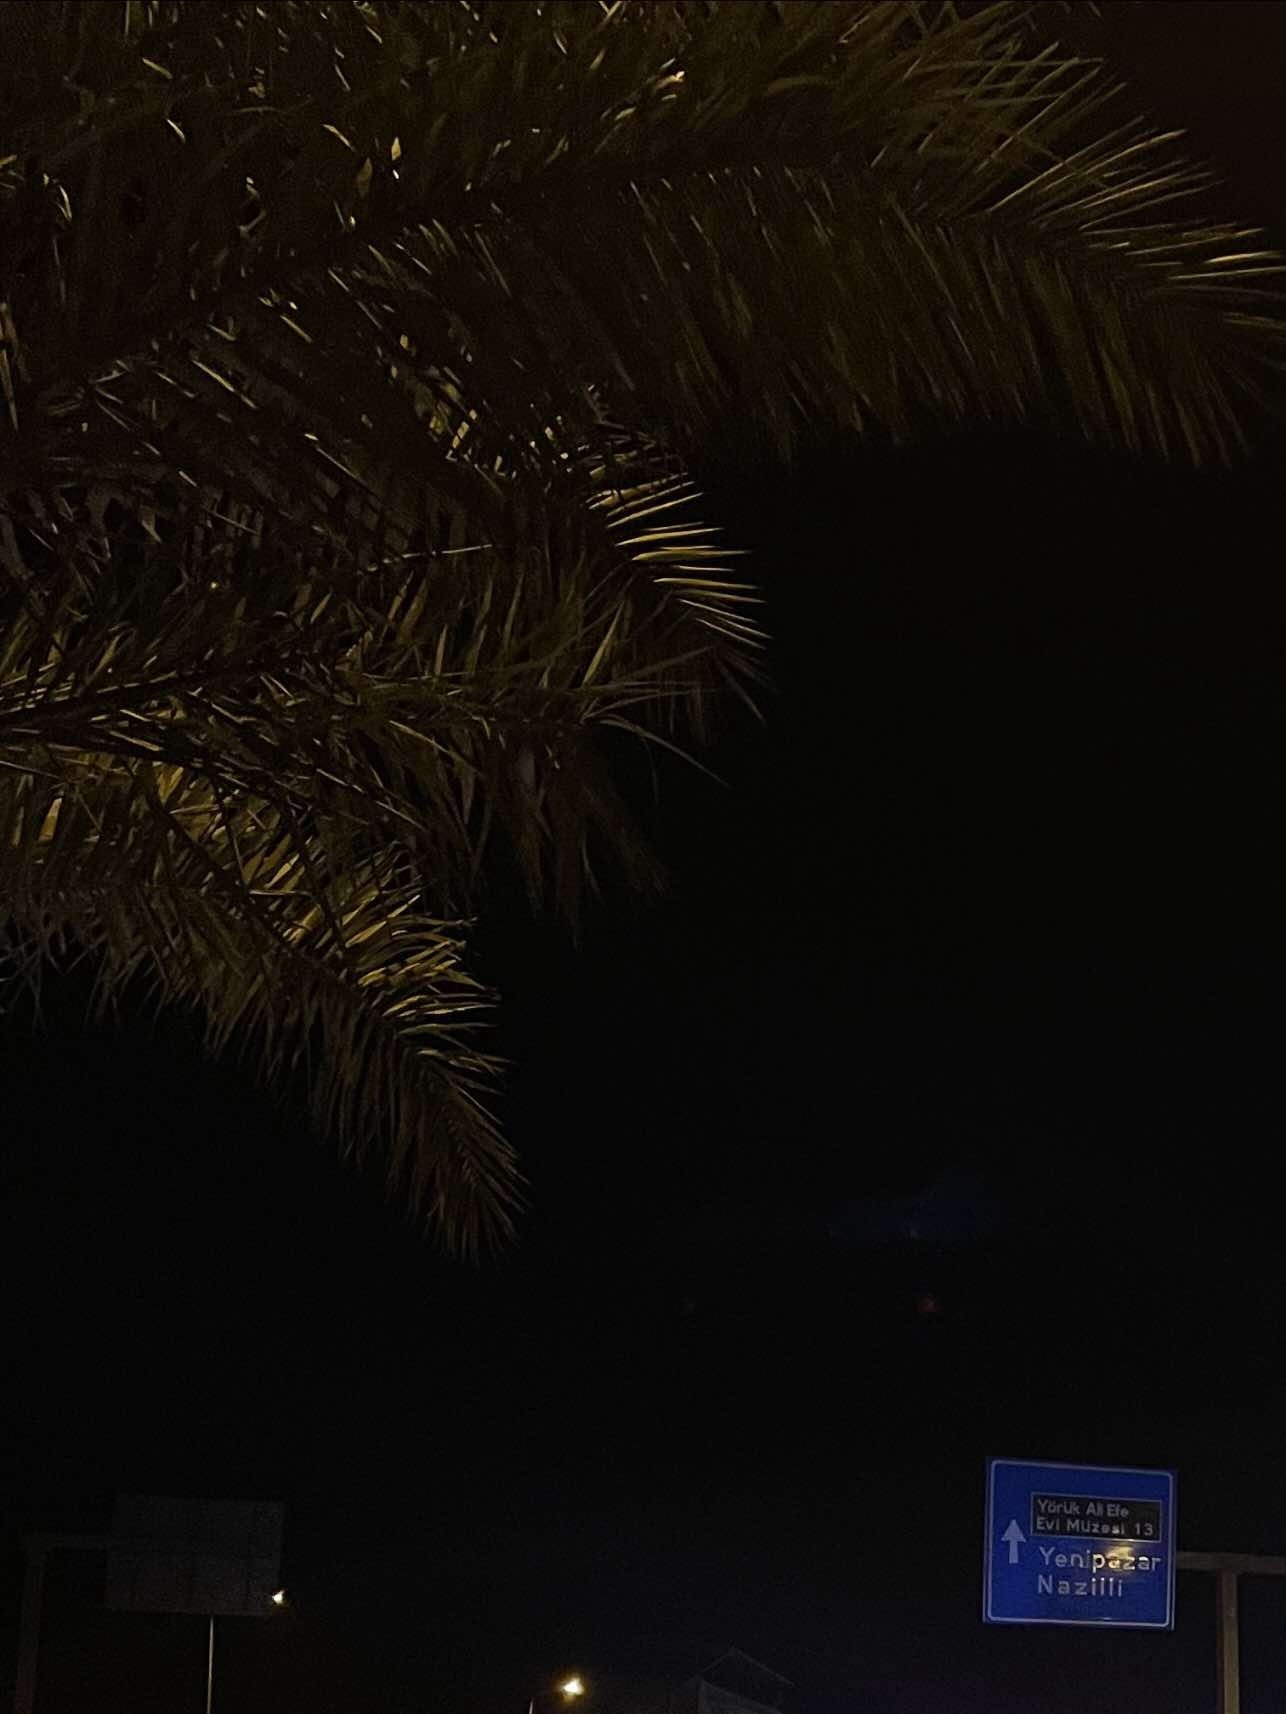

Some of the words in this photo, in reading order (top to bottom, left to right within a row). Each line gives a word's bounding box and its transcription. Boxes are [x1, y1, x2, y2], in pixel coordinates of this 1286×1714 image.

[1106, 1504, 1129, 1517] Efe
[1036, 1516, 1060, 1531] Evi
[1135, 1523, 1154, 1536] 13
[1039, 1546, 1161, 1573] Yenipazar
[1038, 1574, 1123, 1597] Nazilli
